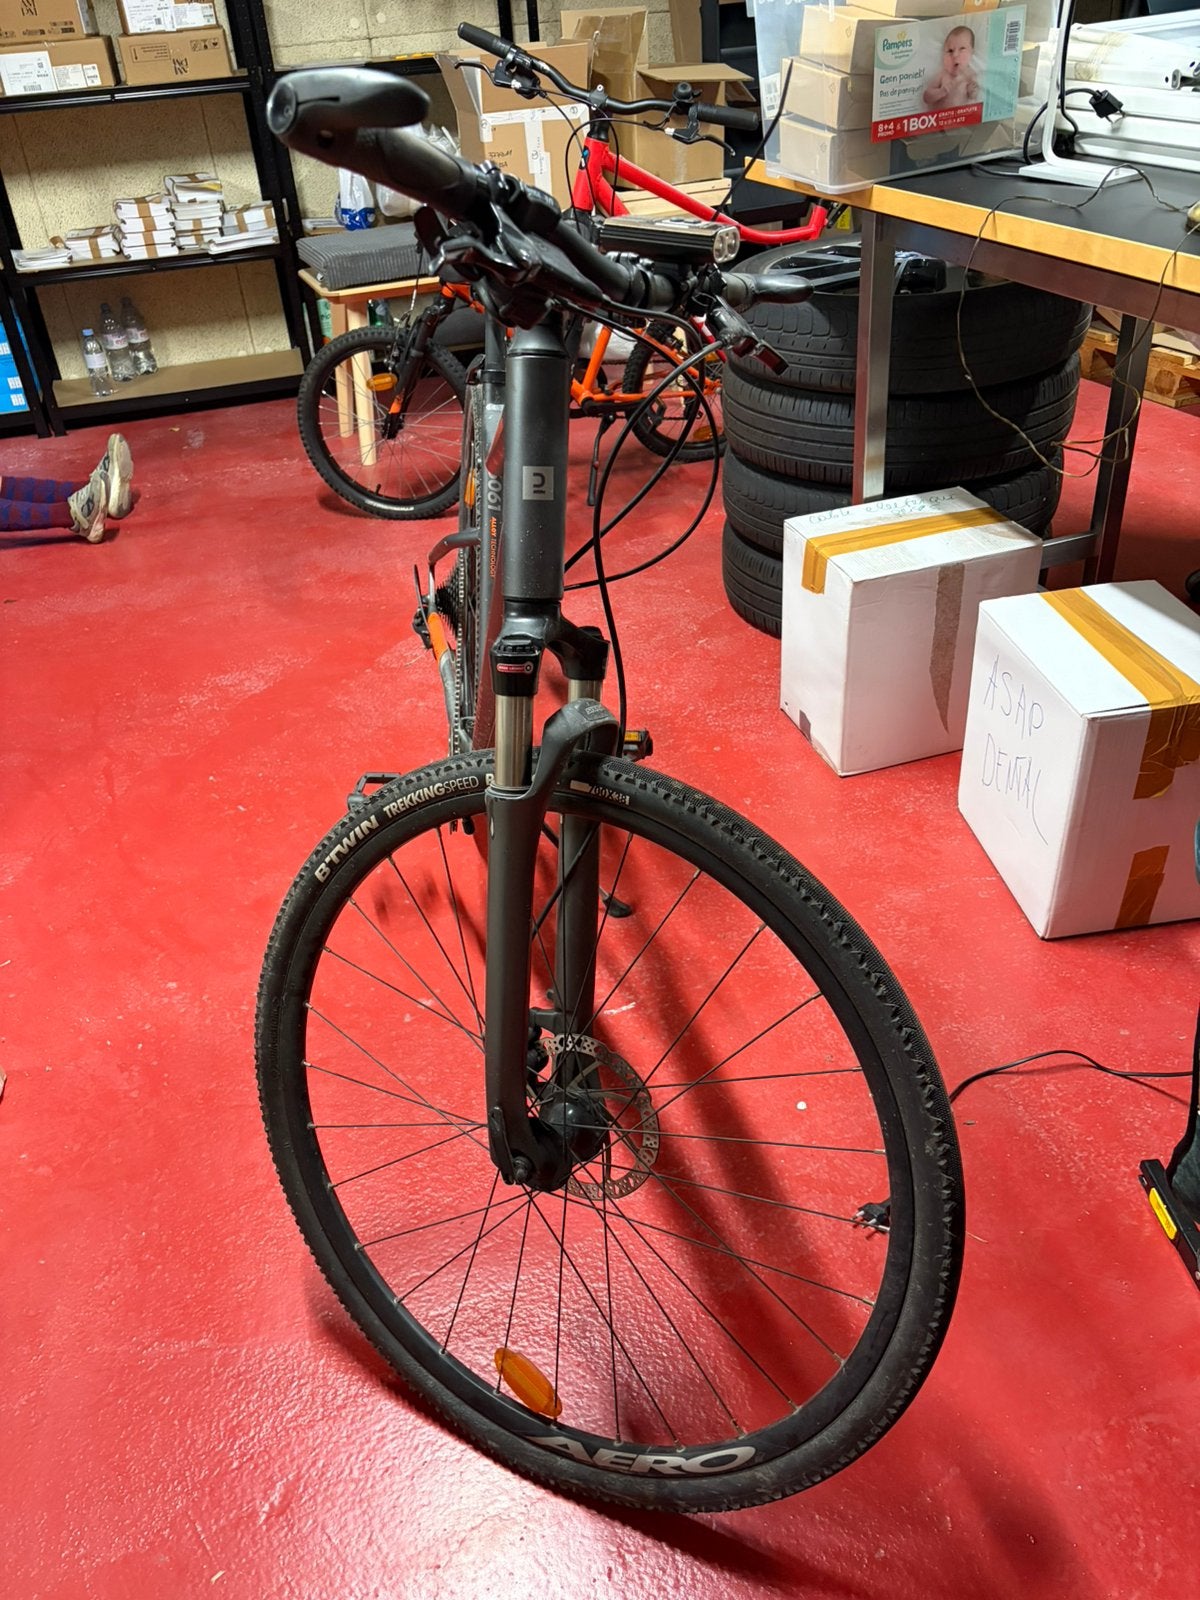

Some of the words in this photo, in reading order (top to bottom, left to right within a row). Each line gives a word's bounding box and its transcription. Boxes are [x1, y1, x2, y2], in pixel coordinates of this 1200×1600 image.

[882, 38, 913, 51] Pampers
[879, 74, 898, 84] Geen
[880, 89, 889, 97] Pas
[877, 130, 894, 138] PROMO
[878, 121, 894, 132] 8+4
[487, 472, 502, 511] 061
[489, 516, 498, 537] ALLOY
[489, 538, 498, 578] TECHNOLOGY
[983, 654, 1044, 740] ASAP
[314, 814, 380, 884] B'TWIN
[383, 775, 480, 819] TREKKINGSPEED
[525, 1436, 756, 1475] AERO
